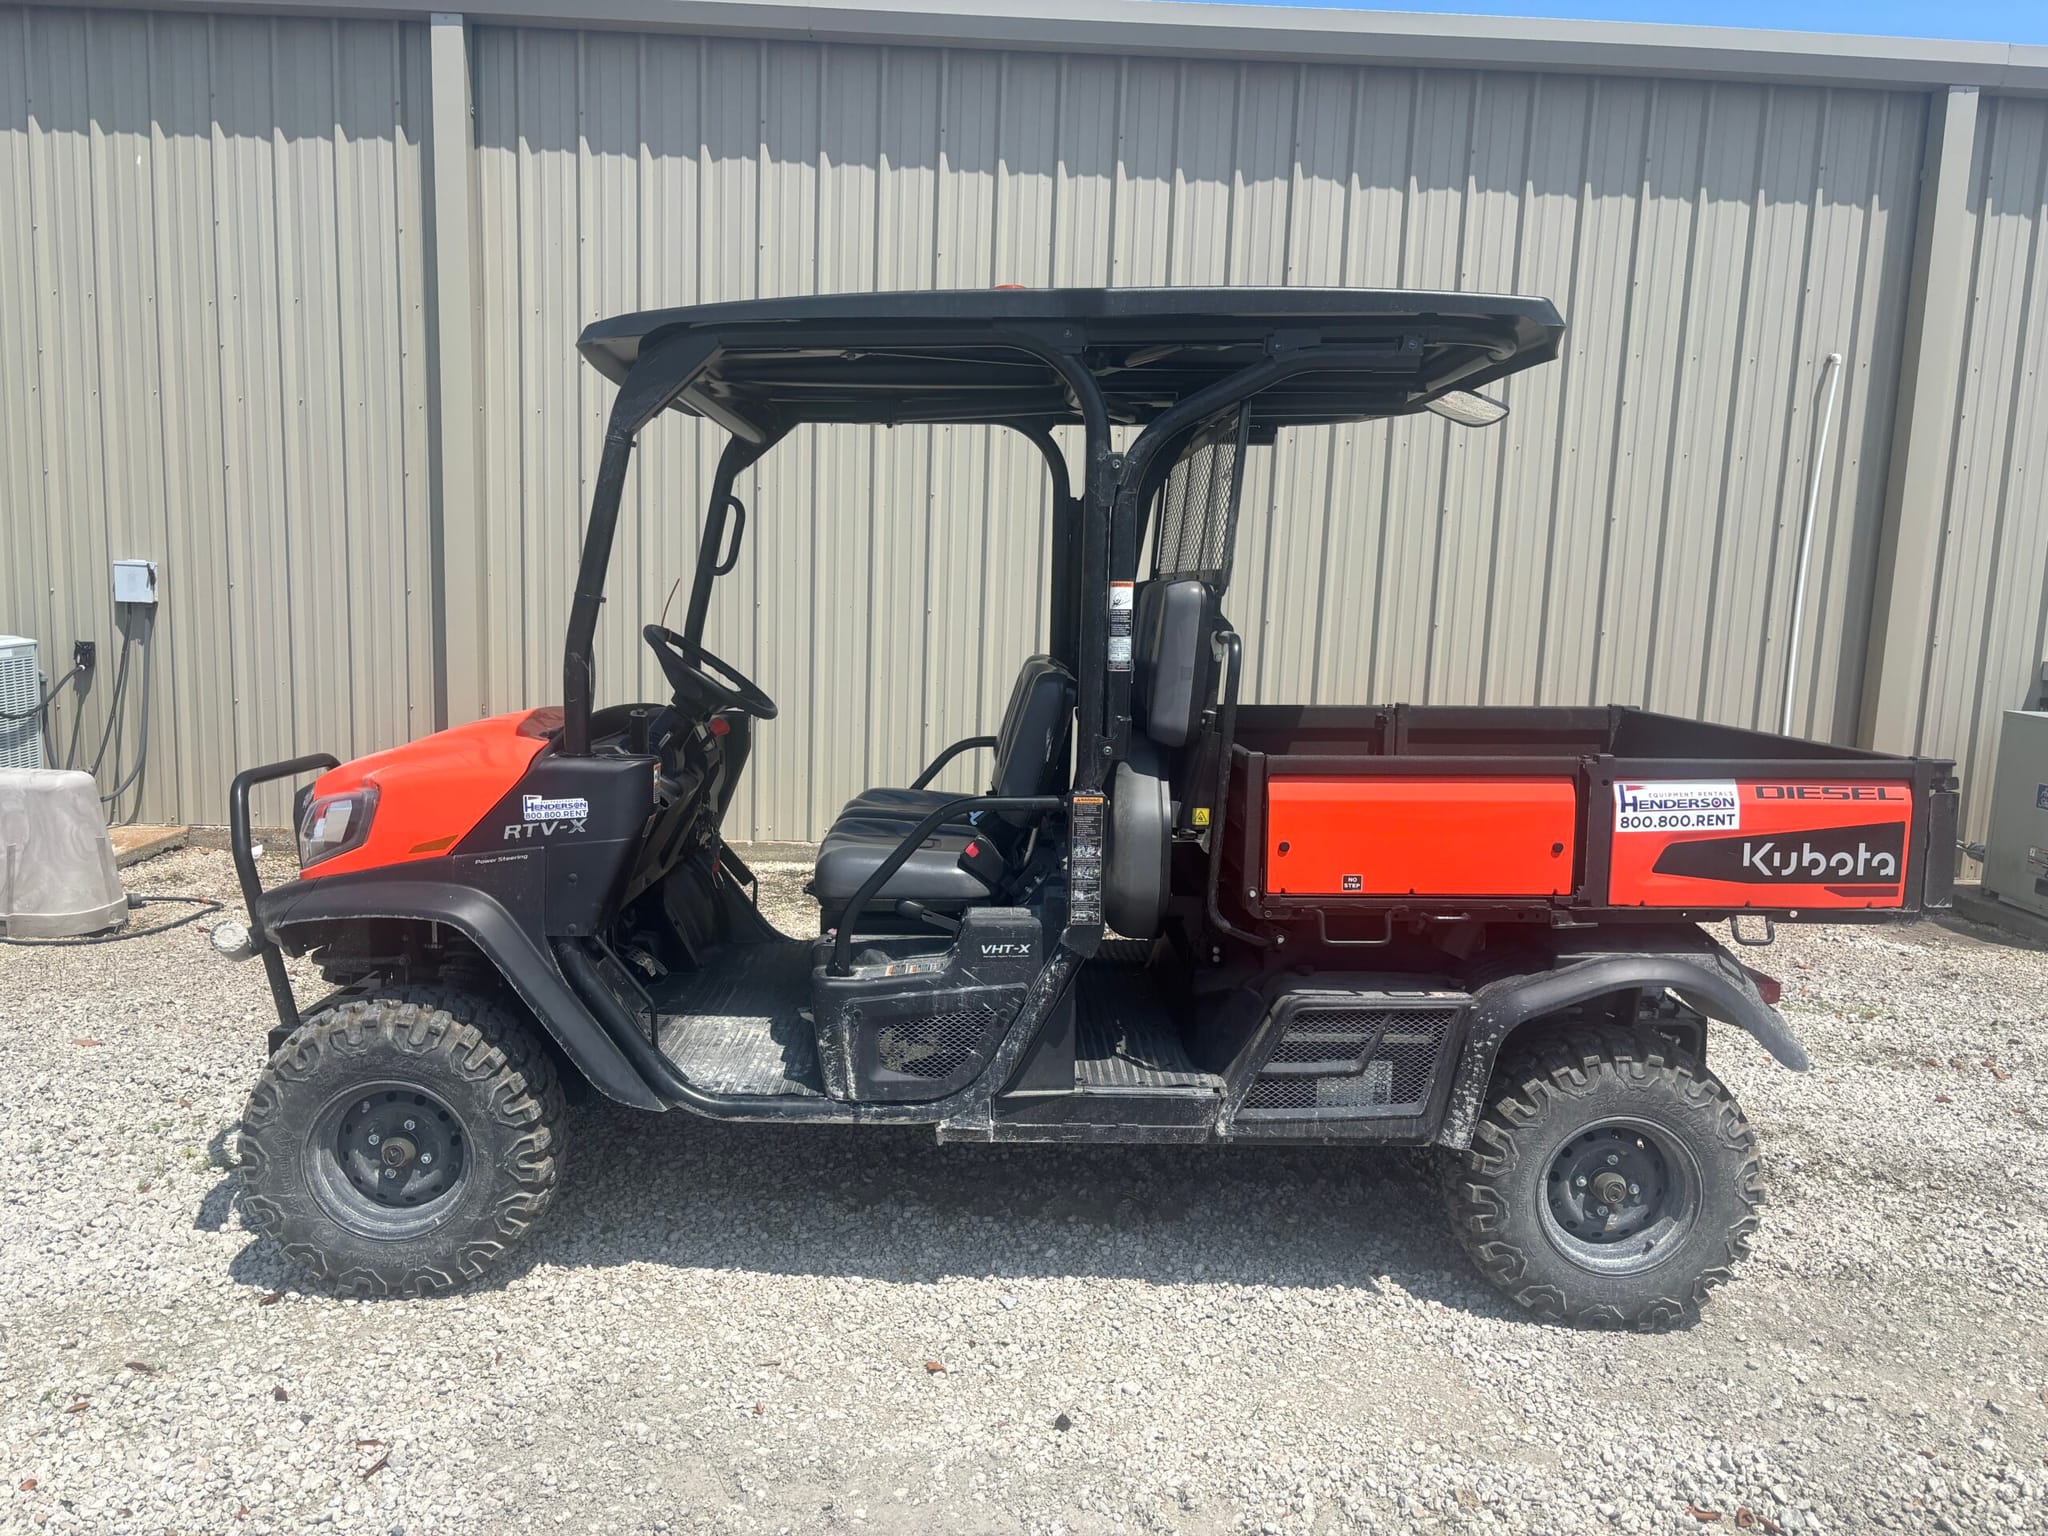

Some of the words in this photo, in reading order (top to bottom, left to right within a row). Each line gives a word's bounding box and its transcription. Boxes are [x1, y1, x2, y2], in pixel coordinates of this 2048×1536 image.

[1618, 784, 1736, 813] HENDERSON
[1648, 791, 1694, 799] EQUIPMENT
[1698, 790, 1734, 798] RENTALS
[1755, 785, 1905, 801] DIESEL
[524, 796, 588, 813] HENDERSON
[525, 809, 588, 820] 800.800.RENT
[1620, 813, 1736, 829] 800.800.RENT
[503, 818, 588, 840] RTV-X
[474, 857, 497, 865] Power
[498, 853, 529, 863] Steering
[1742, 842, 1896, 877] Kubota
[981, 943, 1031, 954] VHT-X
